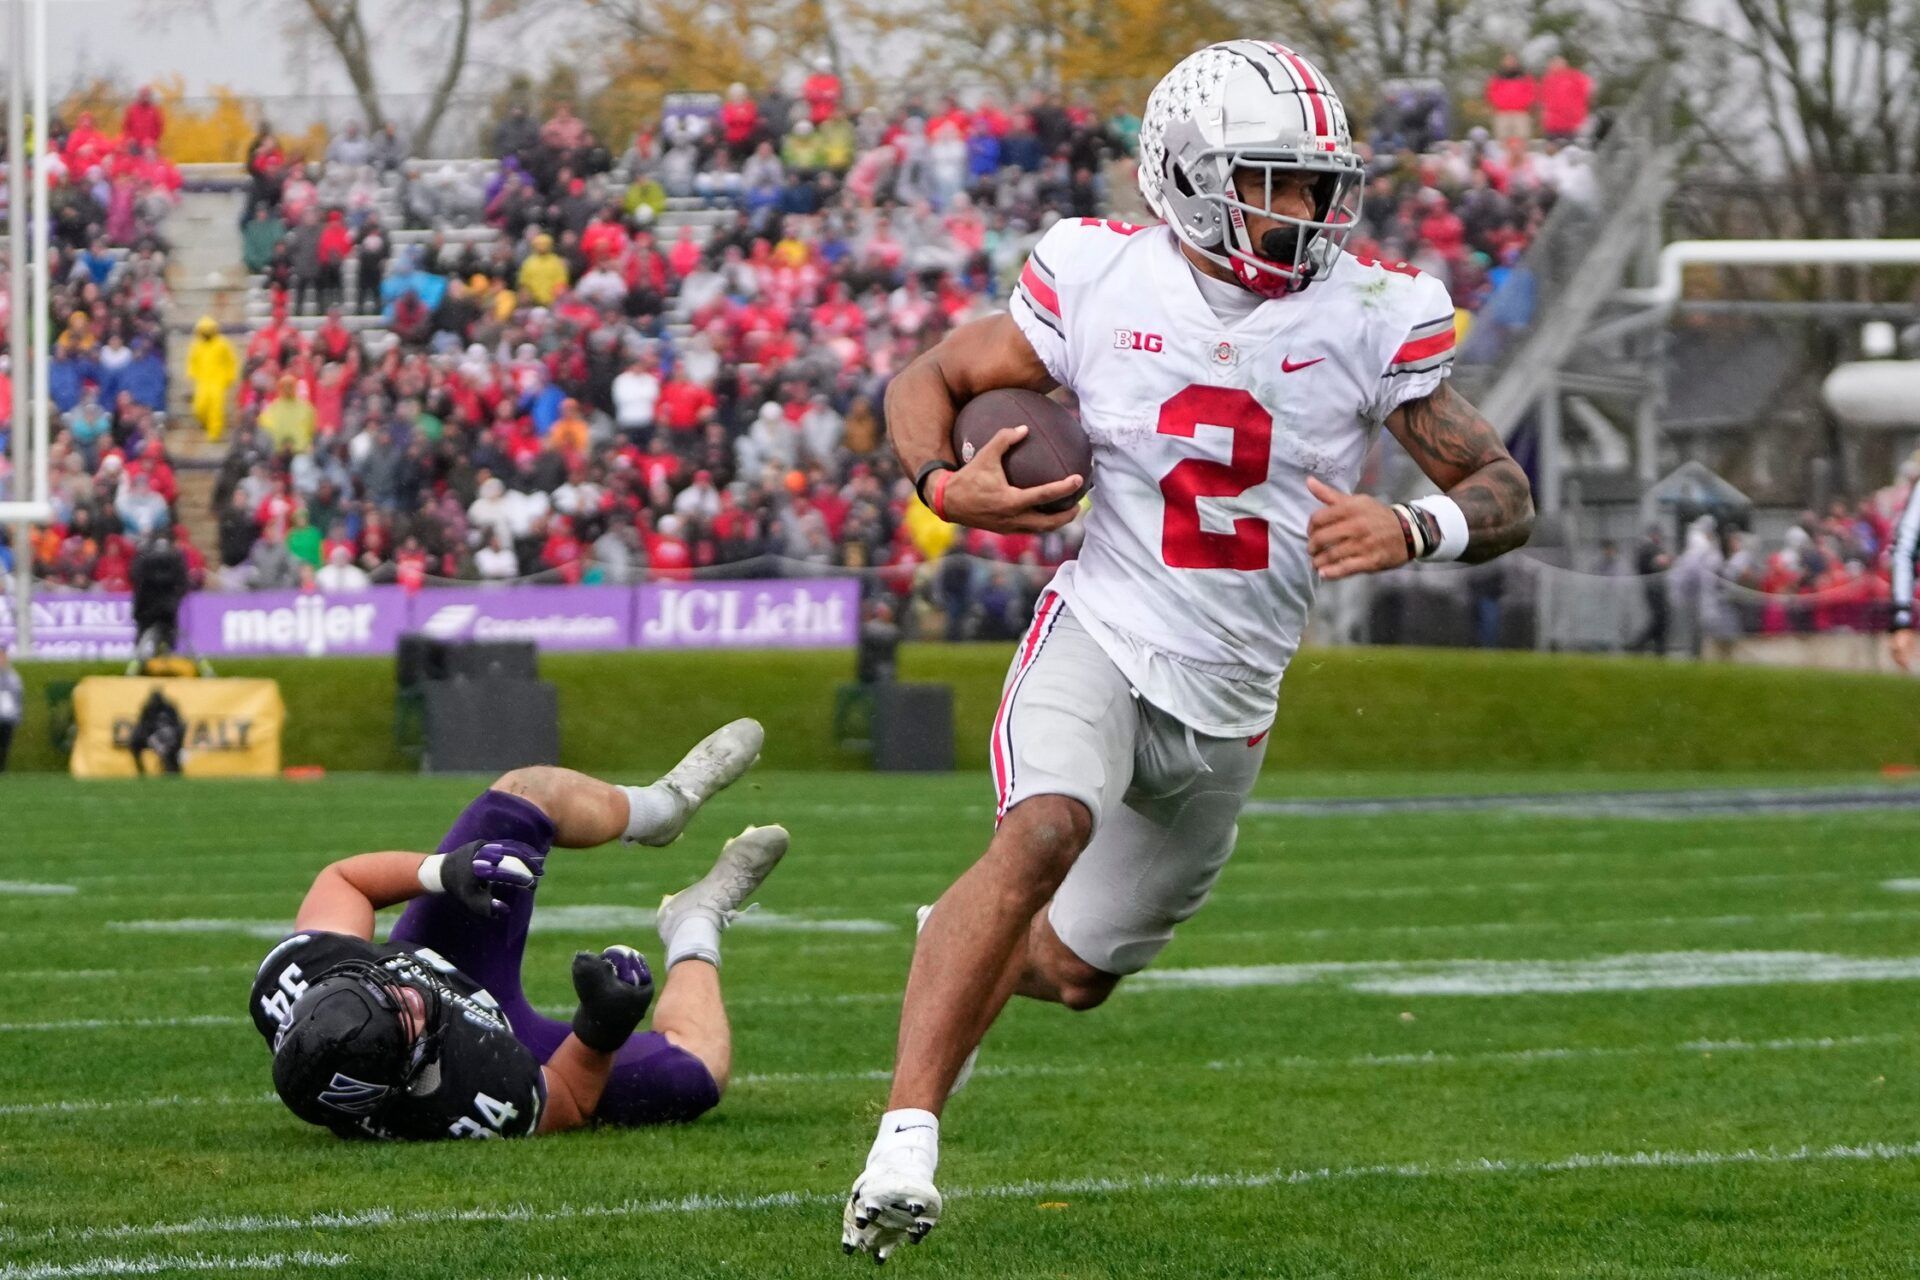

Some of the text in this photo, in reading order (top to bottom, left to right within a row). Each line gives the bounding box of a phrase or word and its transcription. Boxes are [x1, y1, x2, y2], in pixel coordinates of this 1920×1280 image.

[1230, 208, 1245, 229] STATE
[1157, 383, 1274, 571] 2
[222, 594, 375, 657] meijer
[642, 588, 845, 640] JCLicht
[111, 718, 253, 750] DALT
[261, 962, 309, 1022] 34
[449, 1092, 519, 1139] 34
